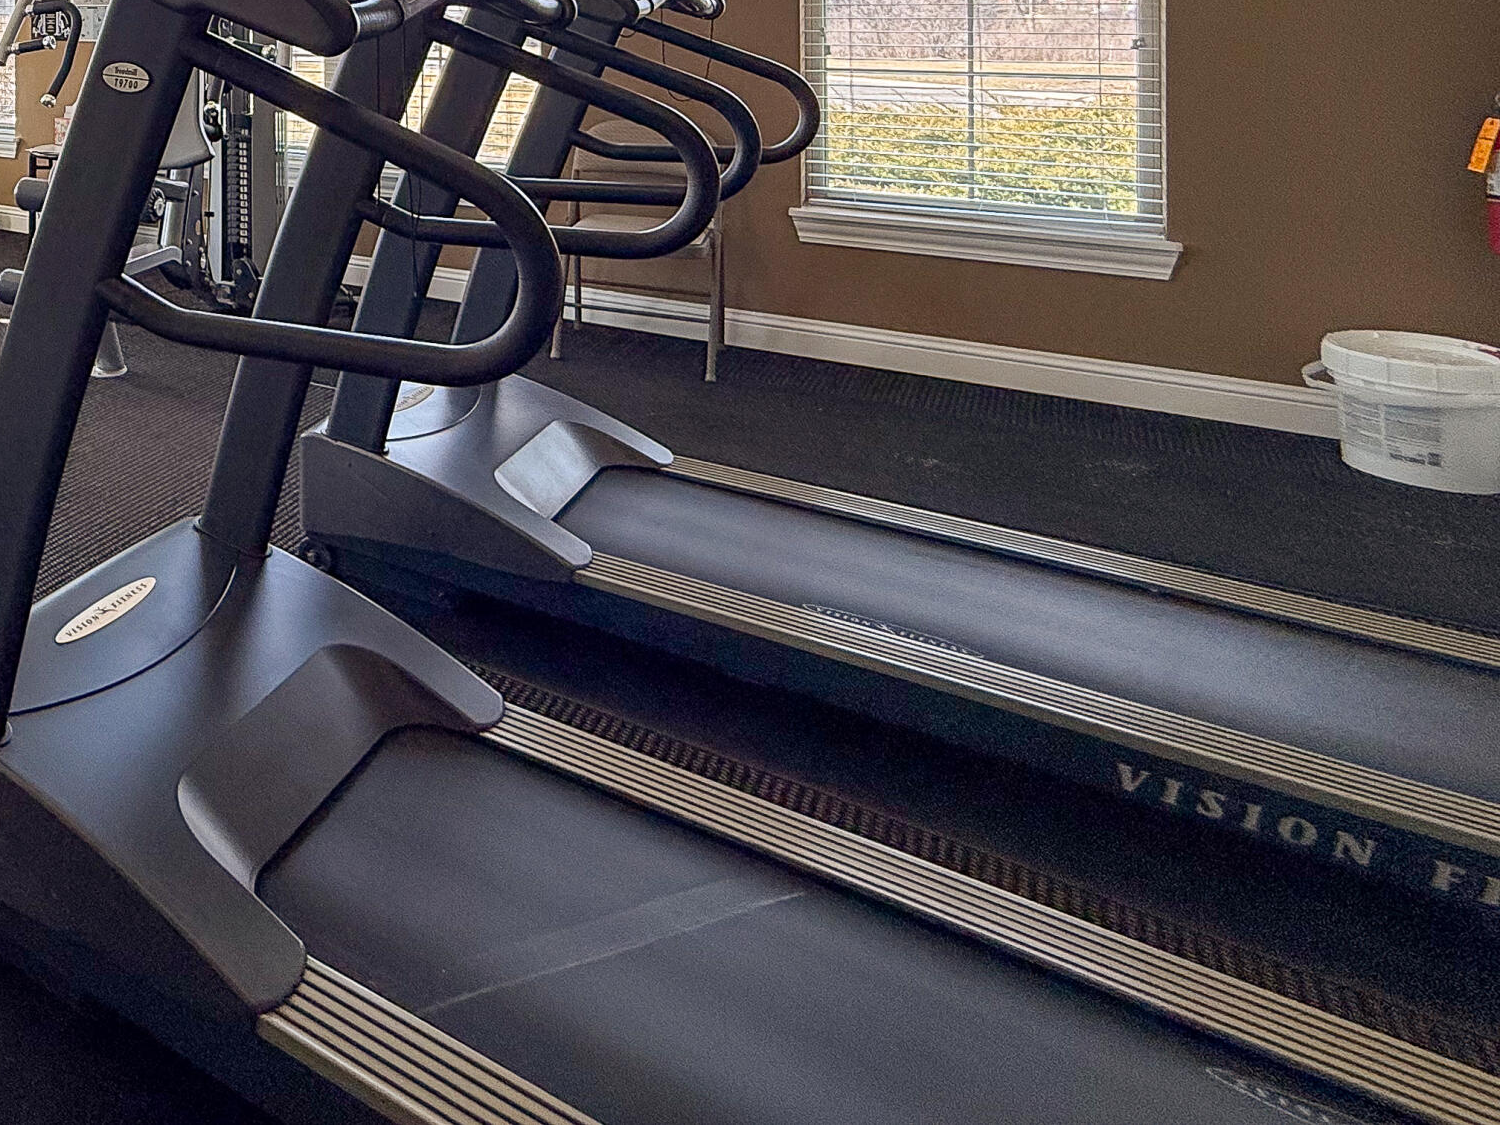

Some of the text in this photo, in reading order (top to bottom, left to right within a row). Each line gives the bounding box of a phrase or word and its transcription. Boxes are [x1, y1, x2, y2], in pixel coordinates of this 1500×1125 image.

[114, 78, 139, 89] T9700
[65, 582, 148, 637] VISION FITNESS
[1115, 761, 1378, 868] VISION
